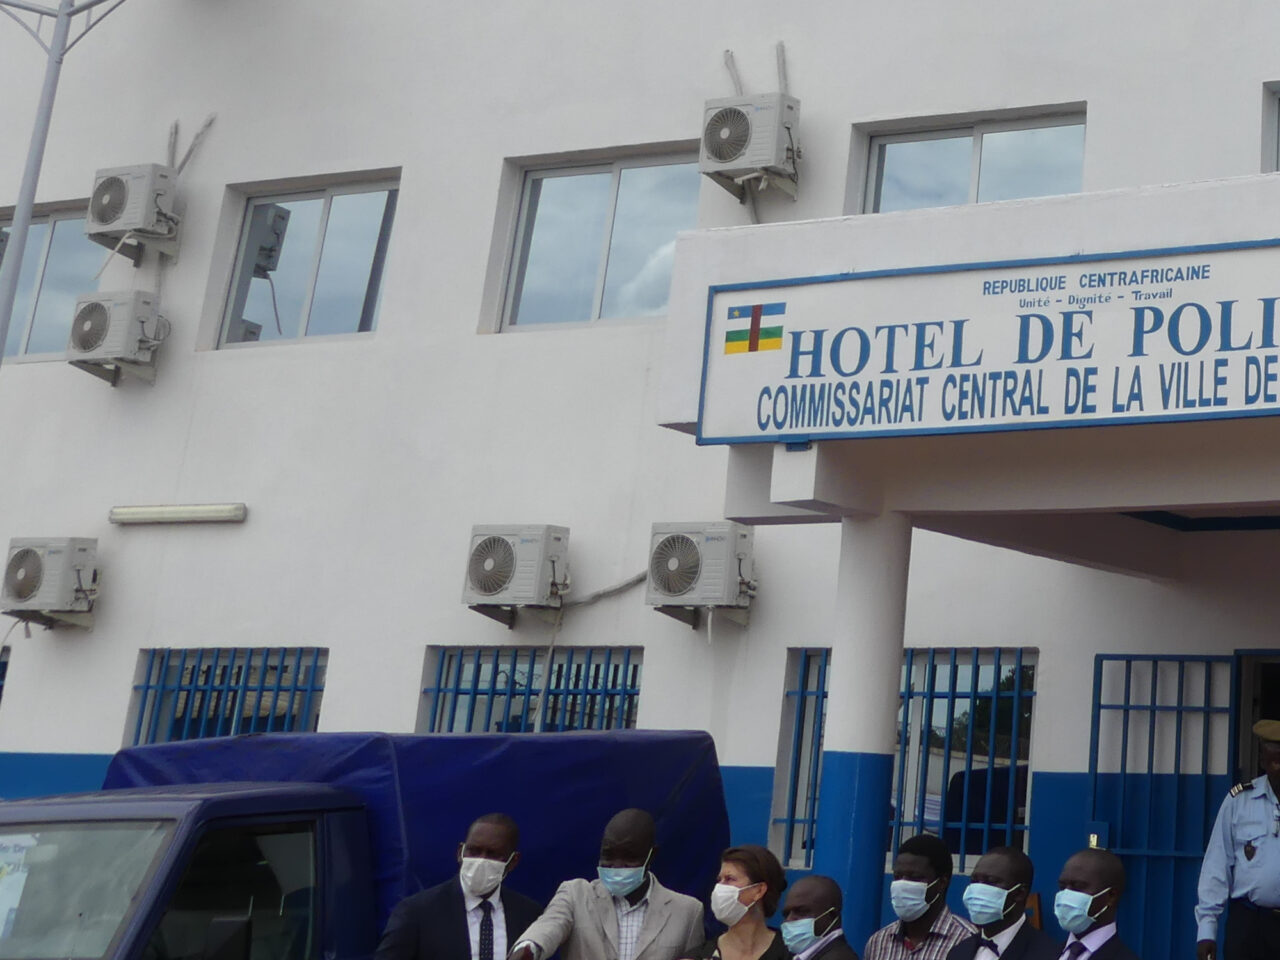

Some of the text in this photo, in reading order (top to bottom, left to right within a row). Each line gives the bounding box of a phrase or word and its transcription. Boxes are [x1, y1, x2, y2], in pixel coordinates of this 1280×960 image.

[983, 264, 1211, 296] REPUBLIQUE CENTRAFRICAINE
[1019, 296, 1051, 309] Unité
[1068, 292, 1112, 310] Dignité
[1131, 287, 1174, 302] Travail
[784, 318, 984, 380] HOTEL
[1012, 310, 1095, 365] DE
[757, 376, 930, 432] COMMISSARIAT
[942, 368, 1050, 422] CENTRAL
[1064, 366, 1099, 416] DE
[1111, 364, 1145, 414] LA
[1158, 357, 1229, 410] VILLE
[1244, 354, 1279, 406] DE
